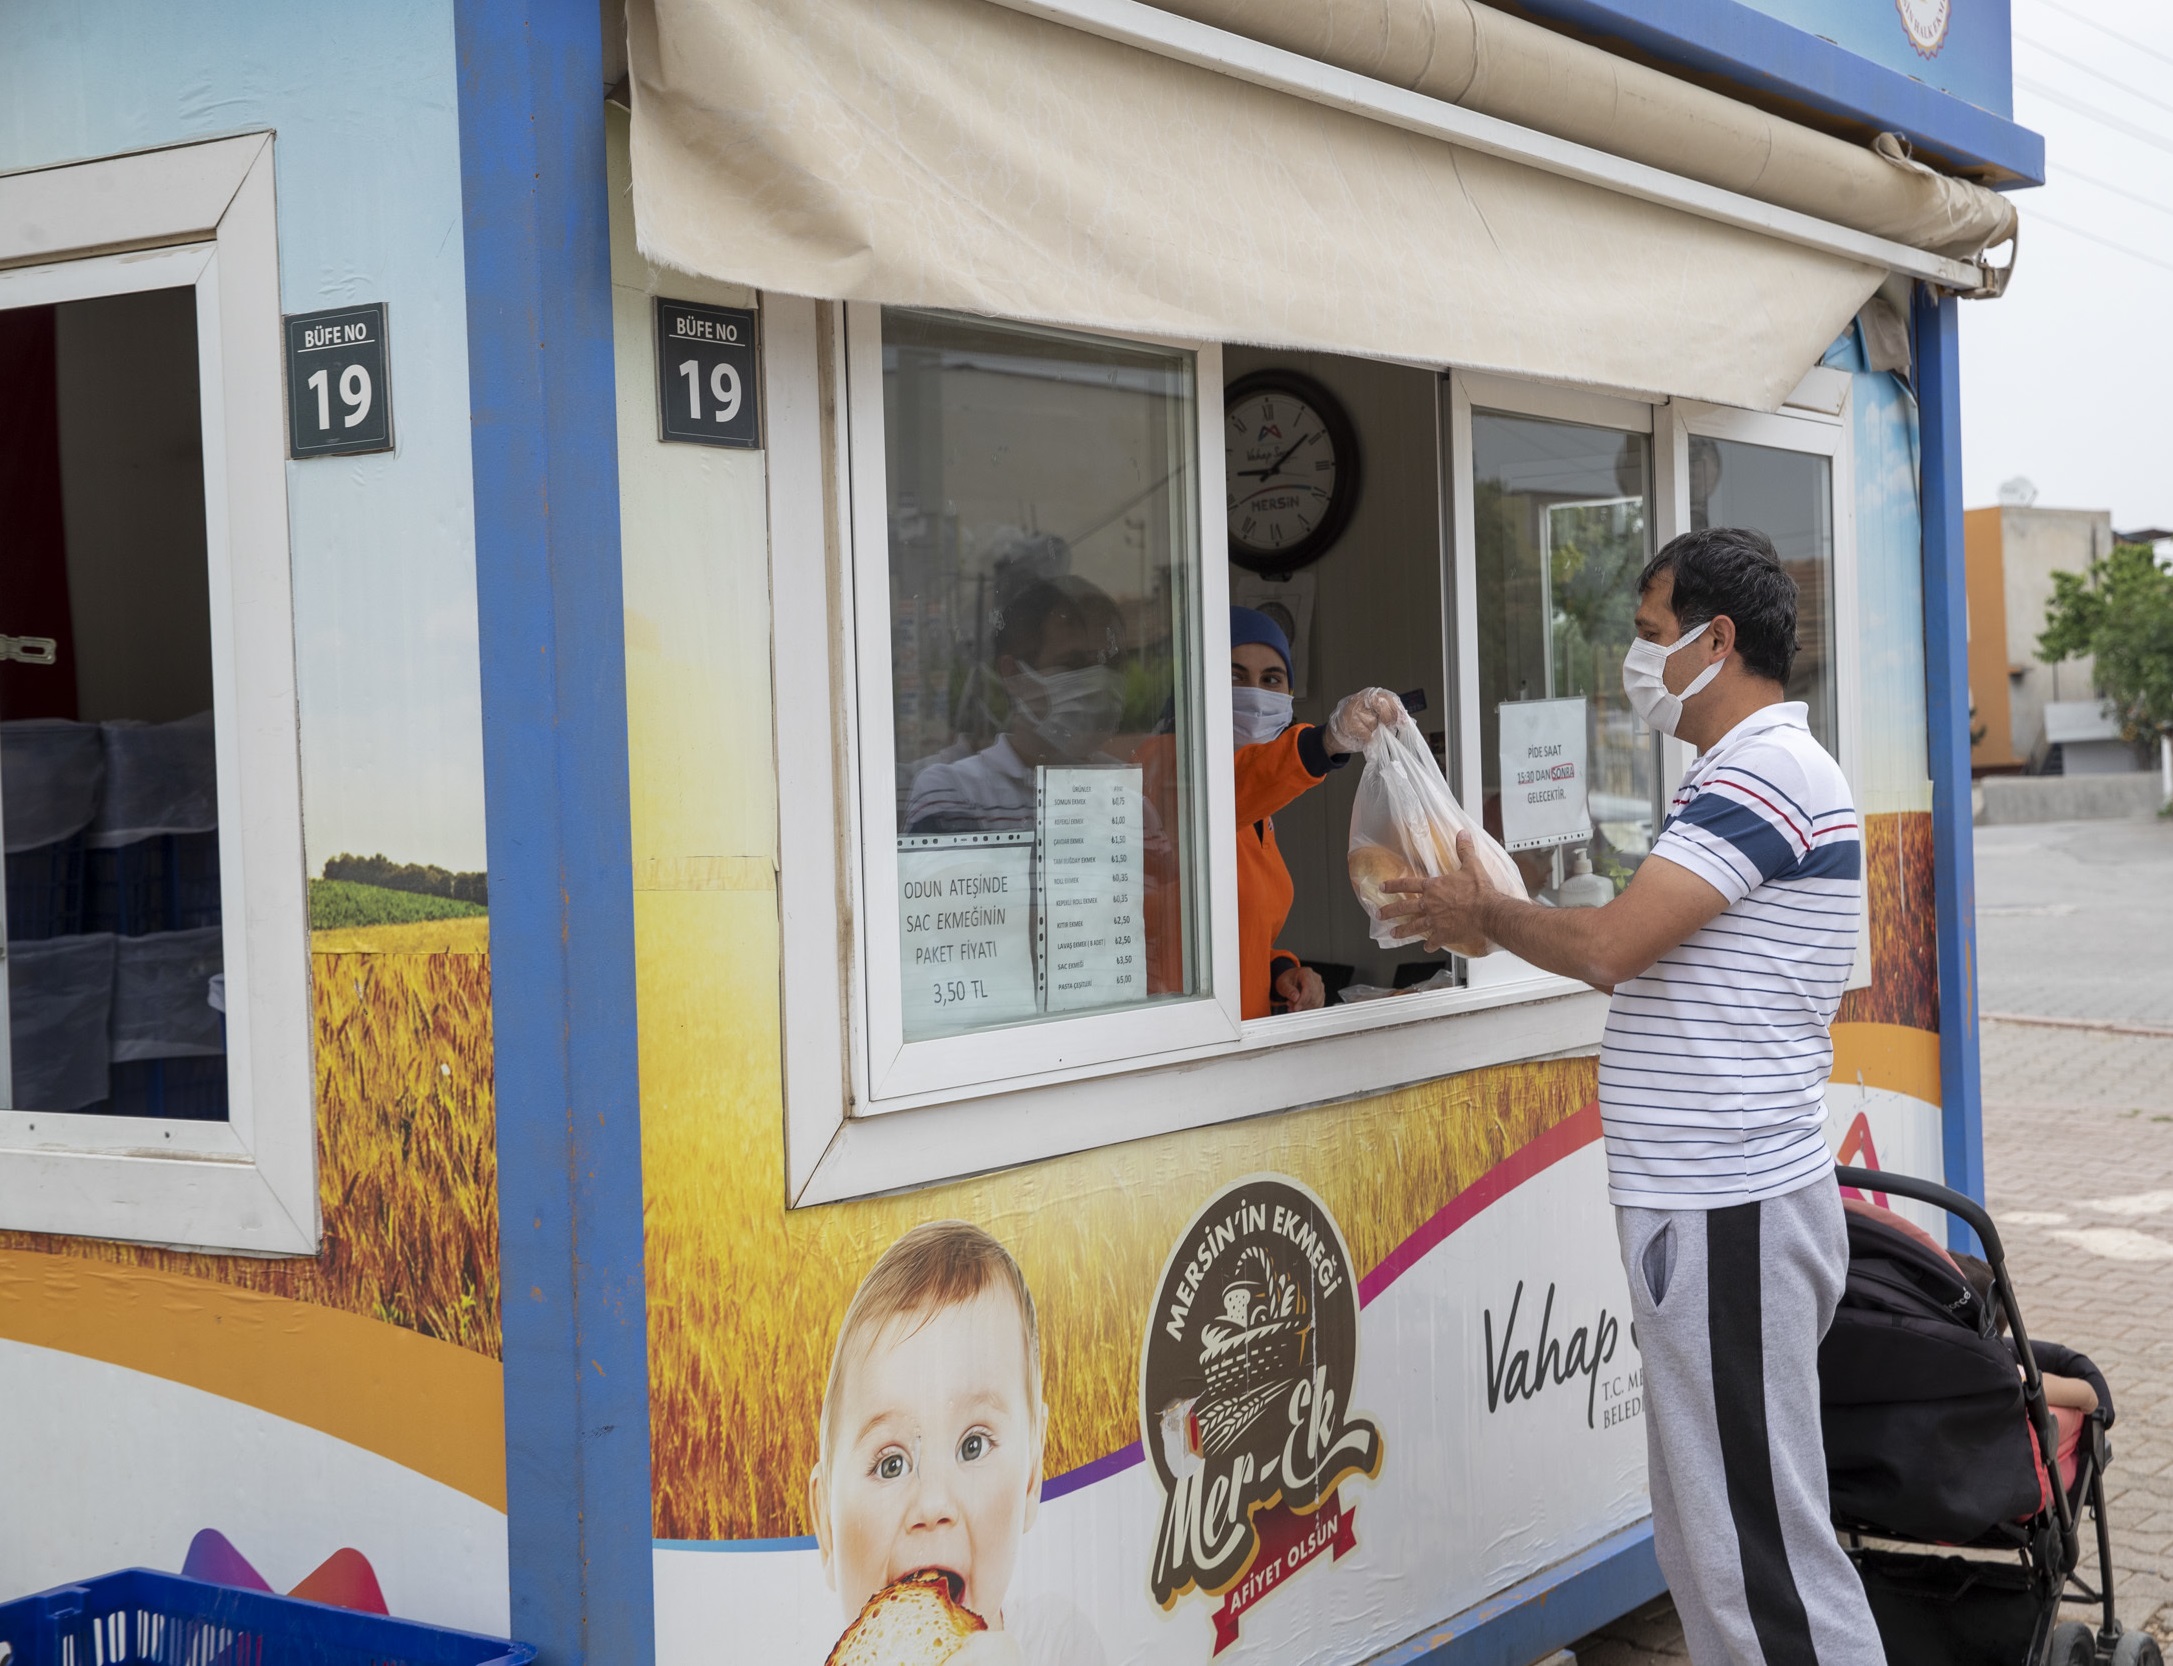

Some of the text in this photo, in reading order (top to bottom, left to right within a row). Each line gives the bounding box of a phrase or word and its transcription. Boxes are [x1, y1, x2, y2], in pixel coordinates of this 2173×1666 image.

[304, 322, 367, 348] BÜFE NO
[676, 315, 738, 342] BÜFE NO
[307, 364, 373, 430] 19
[679, 359, 742, 423] 19
[1527, 743, 1562, 759] PİDE SAAT
[1517, 767, 1574, 783] 15:30 DAN SONRA
[1527, 786, 1567, 804] GELECEKTİR.
[904, 873, 1008, 899] ODUN ATEŞİNDE
[906, 904, 1006, 933] SAC EKMEĞİNİN
[1069, 920, 1084, 928] EKMEK
[915, 939, 997, 965] PAKET FİYATI
[1057, 942, 1073, 951] LAVAŞ
[1073, 940, 1087, 948] EKMEK
[1057, 963, 1067, 971] SAC
[933, 979, 988, 1007] 3,50 TL
[1165, 1198, 1343, 1342] MERSİN'İN EKMEĞİ
[1484, 1280, 1618, 1430] Vahap
[1602, 1367, 1643, 1401] T.C. ME
[1229, 1558, 1282, 1615] AFİYET
